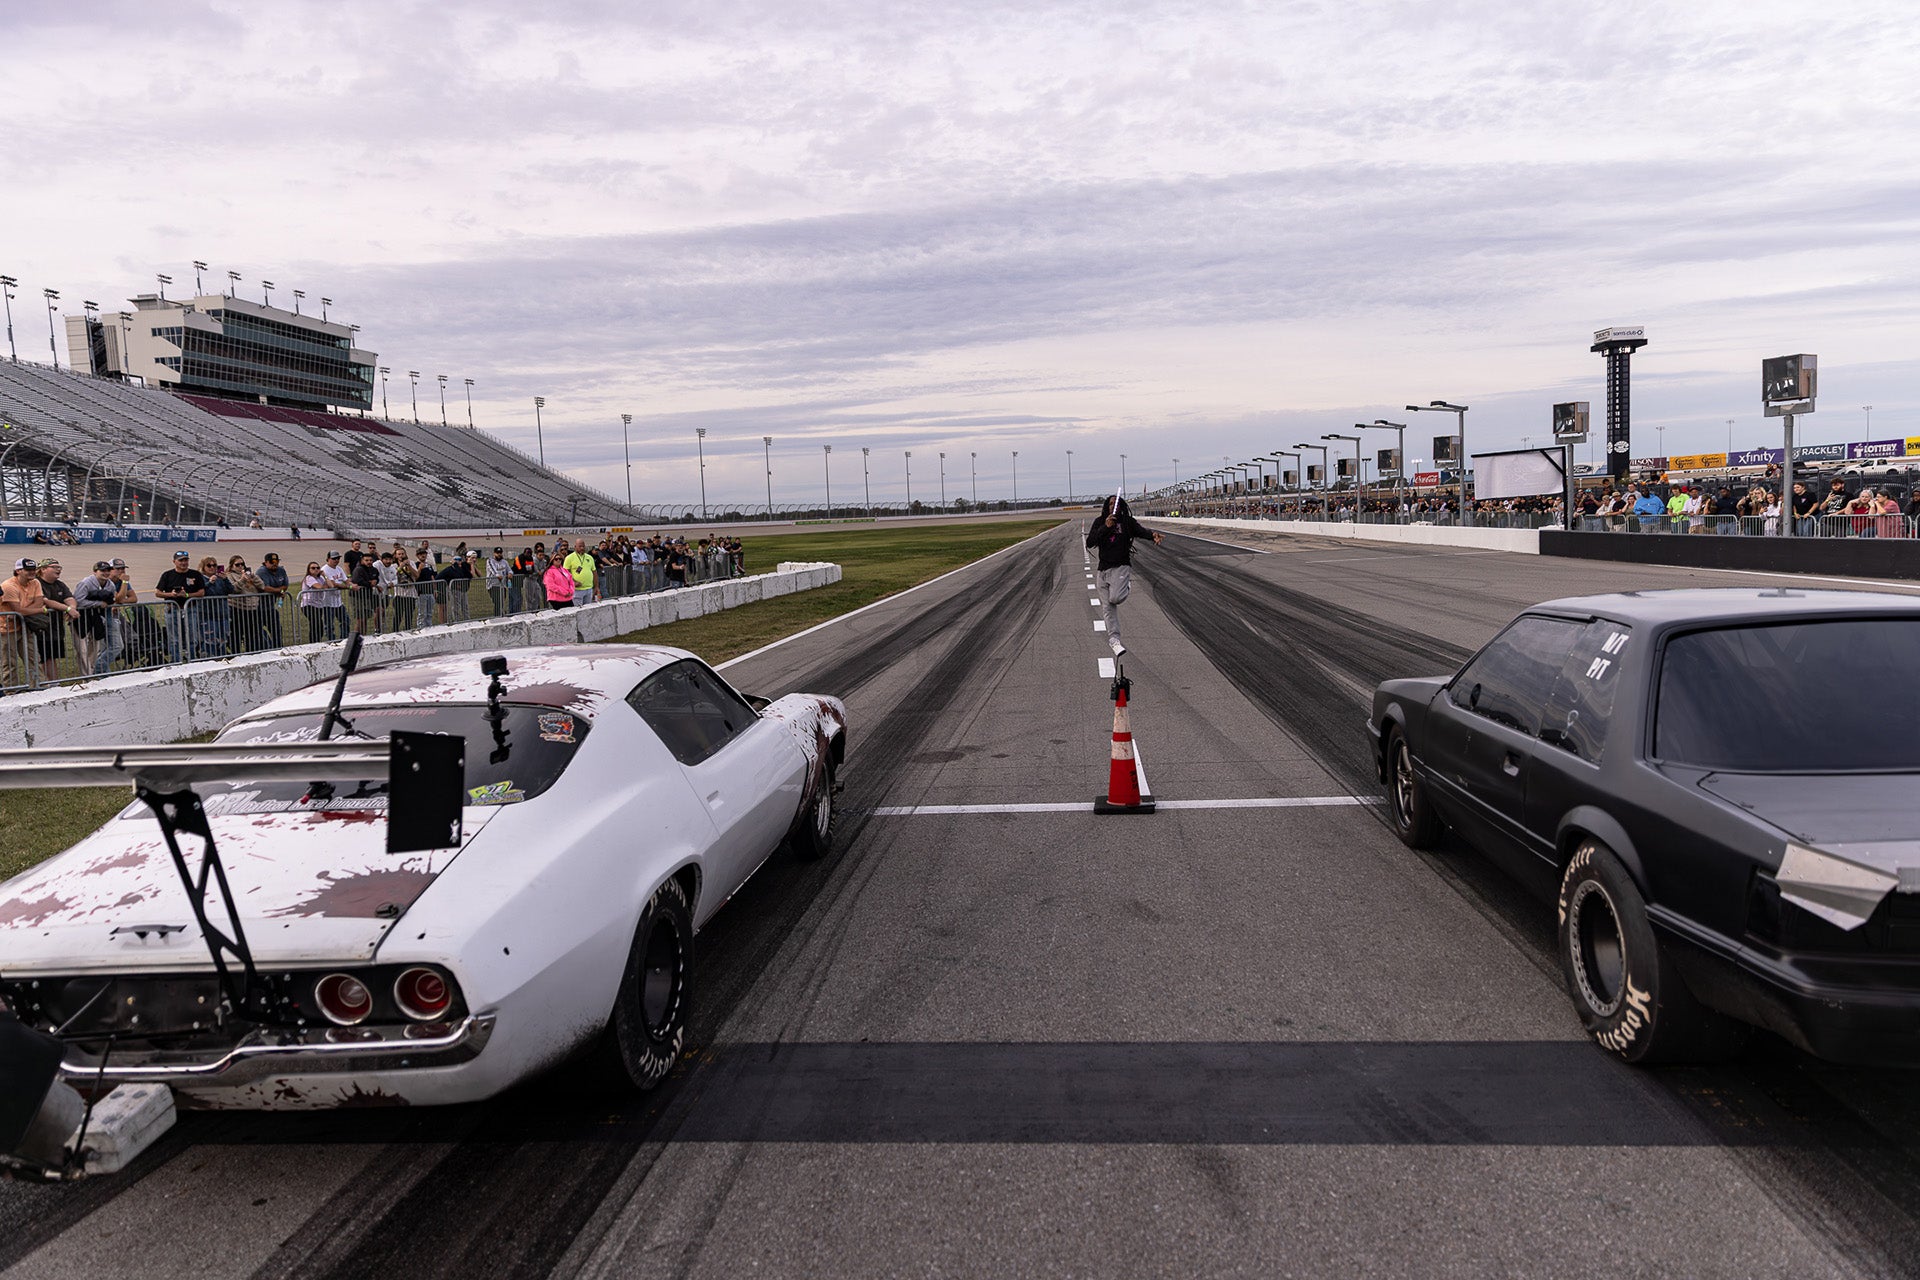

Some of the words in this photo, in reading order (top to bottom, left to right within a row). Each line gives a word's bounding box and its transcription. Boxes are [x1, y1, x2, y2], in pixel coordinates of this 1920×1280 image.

[1802, 446, 1844, 456] RACKLEY
[1864, 443, 1897, 453] LOTTERY
[1738, 451, 1775, 464] xfinity
[109, 530, 131, 538] RACKLEY
[143, 530, 161, 538] RACKLEY
[172, 530, 188, 538] RACKLEY
